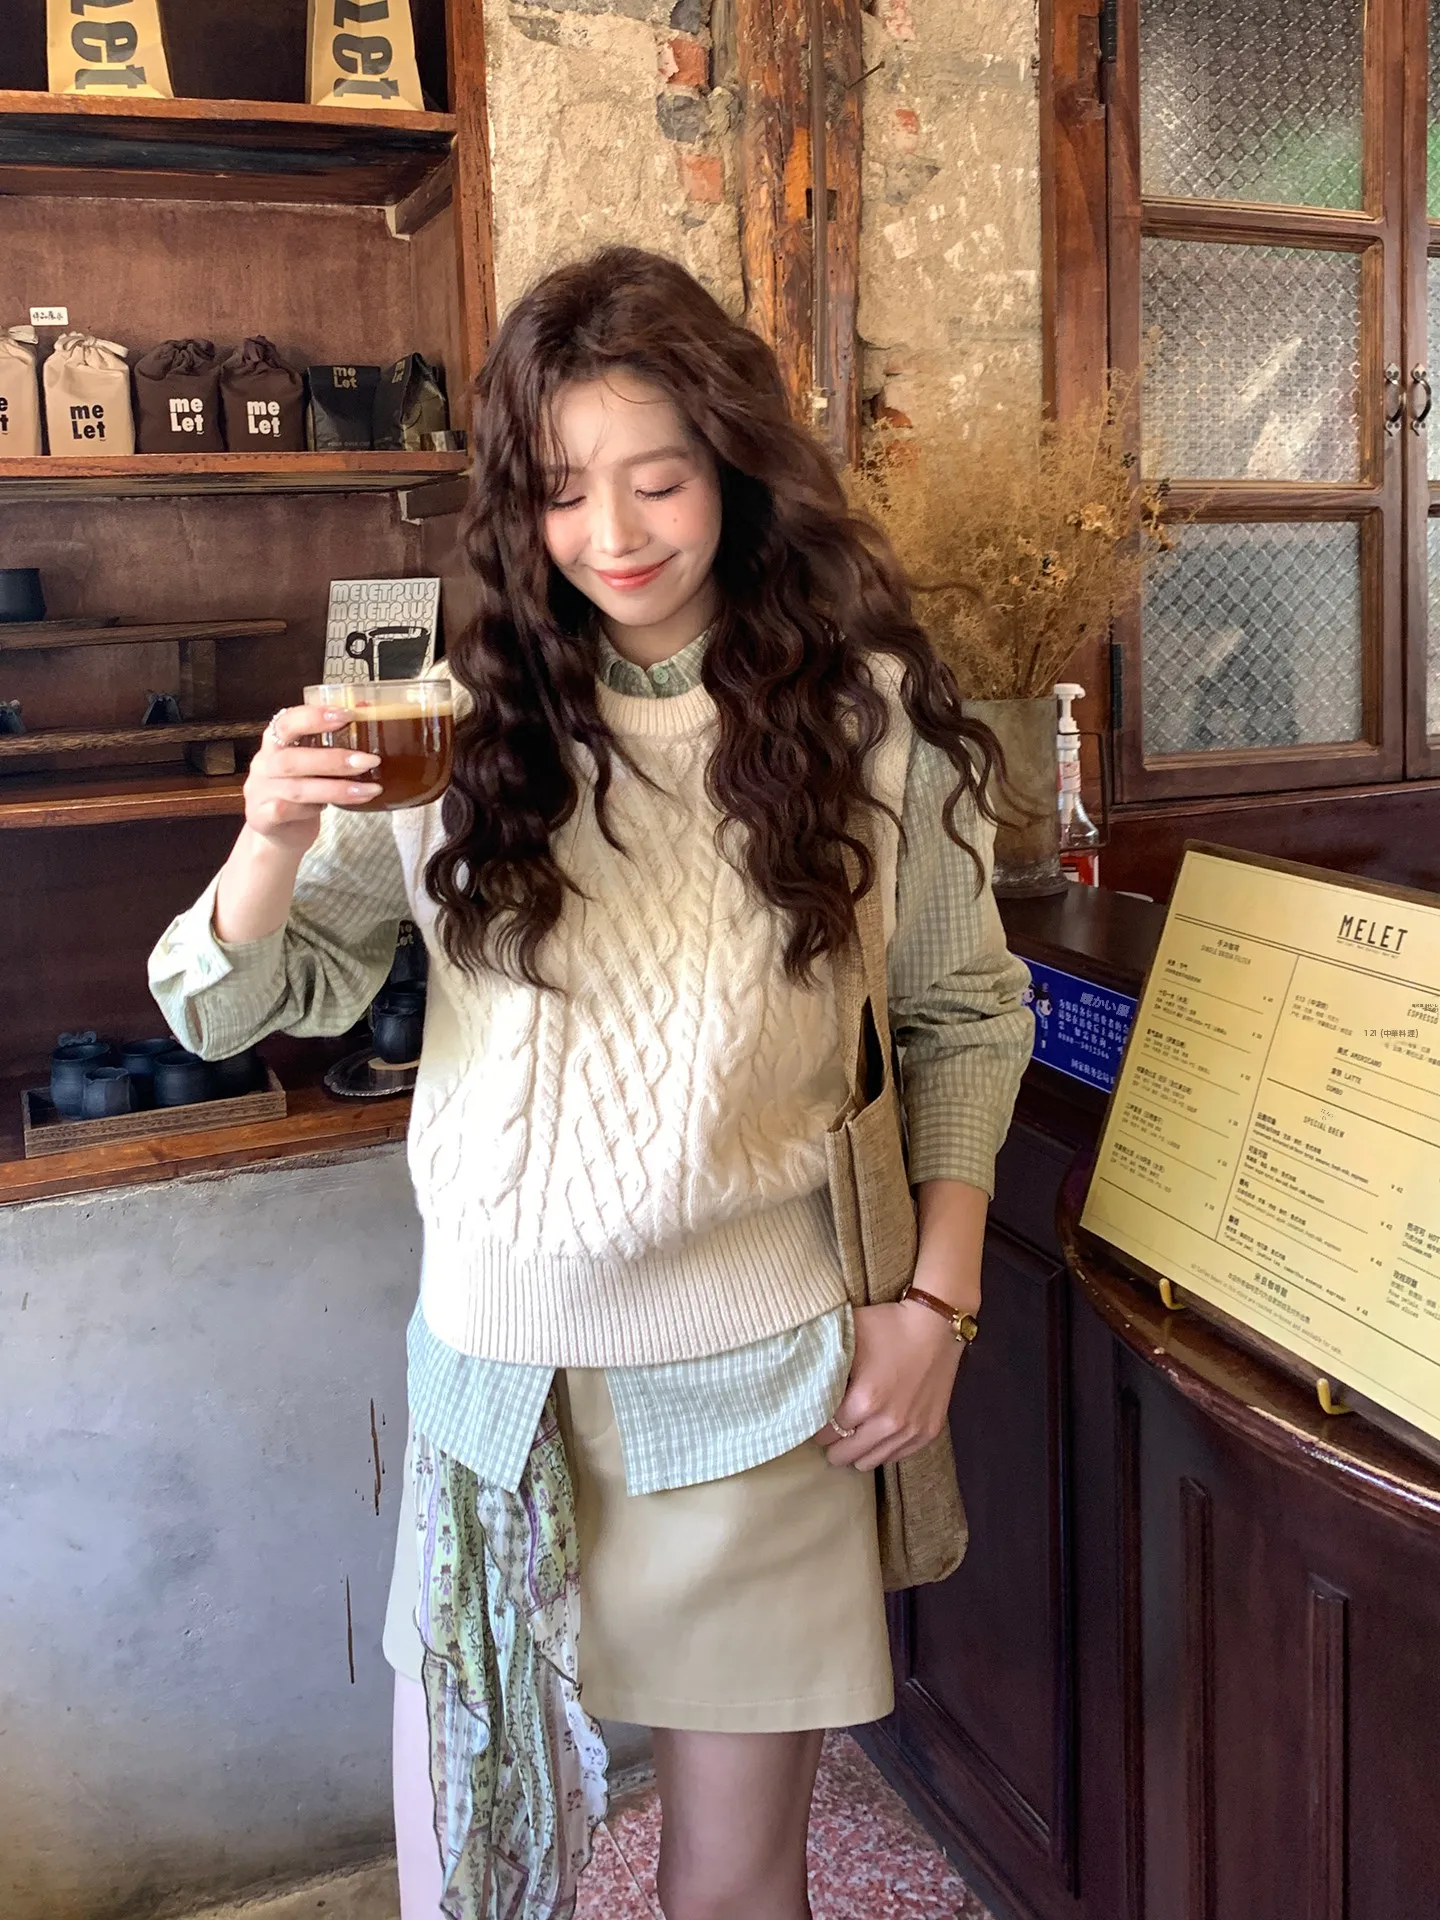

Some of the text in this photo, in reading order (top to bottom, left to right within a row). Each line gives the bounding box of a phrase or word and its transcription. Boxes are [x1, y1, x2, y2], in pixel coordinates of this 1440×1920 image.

[70, 404, 104, 419] me
[169, 397, 203, 413] me
[247, 401, 280, 416] me
[71, 420, 106, 440] Let
[170, 412, 204, 433] Let
[248, 414, 281, 436] Let
[331, 582, 437, 603] MELETPLUS
[329, 600, 435, 621] MELETPLUS
[1338, 914, 1408, 952] MELET
[1407, 1008, 1439, 1025] ESPRESSO
[1350, 1052, 1382, 1068] AMERICANO
[1344, 1072, 1362, 1085] LATTE
[1303, 1115, 1345, 1139] SPECIAL BREW
